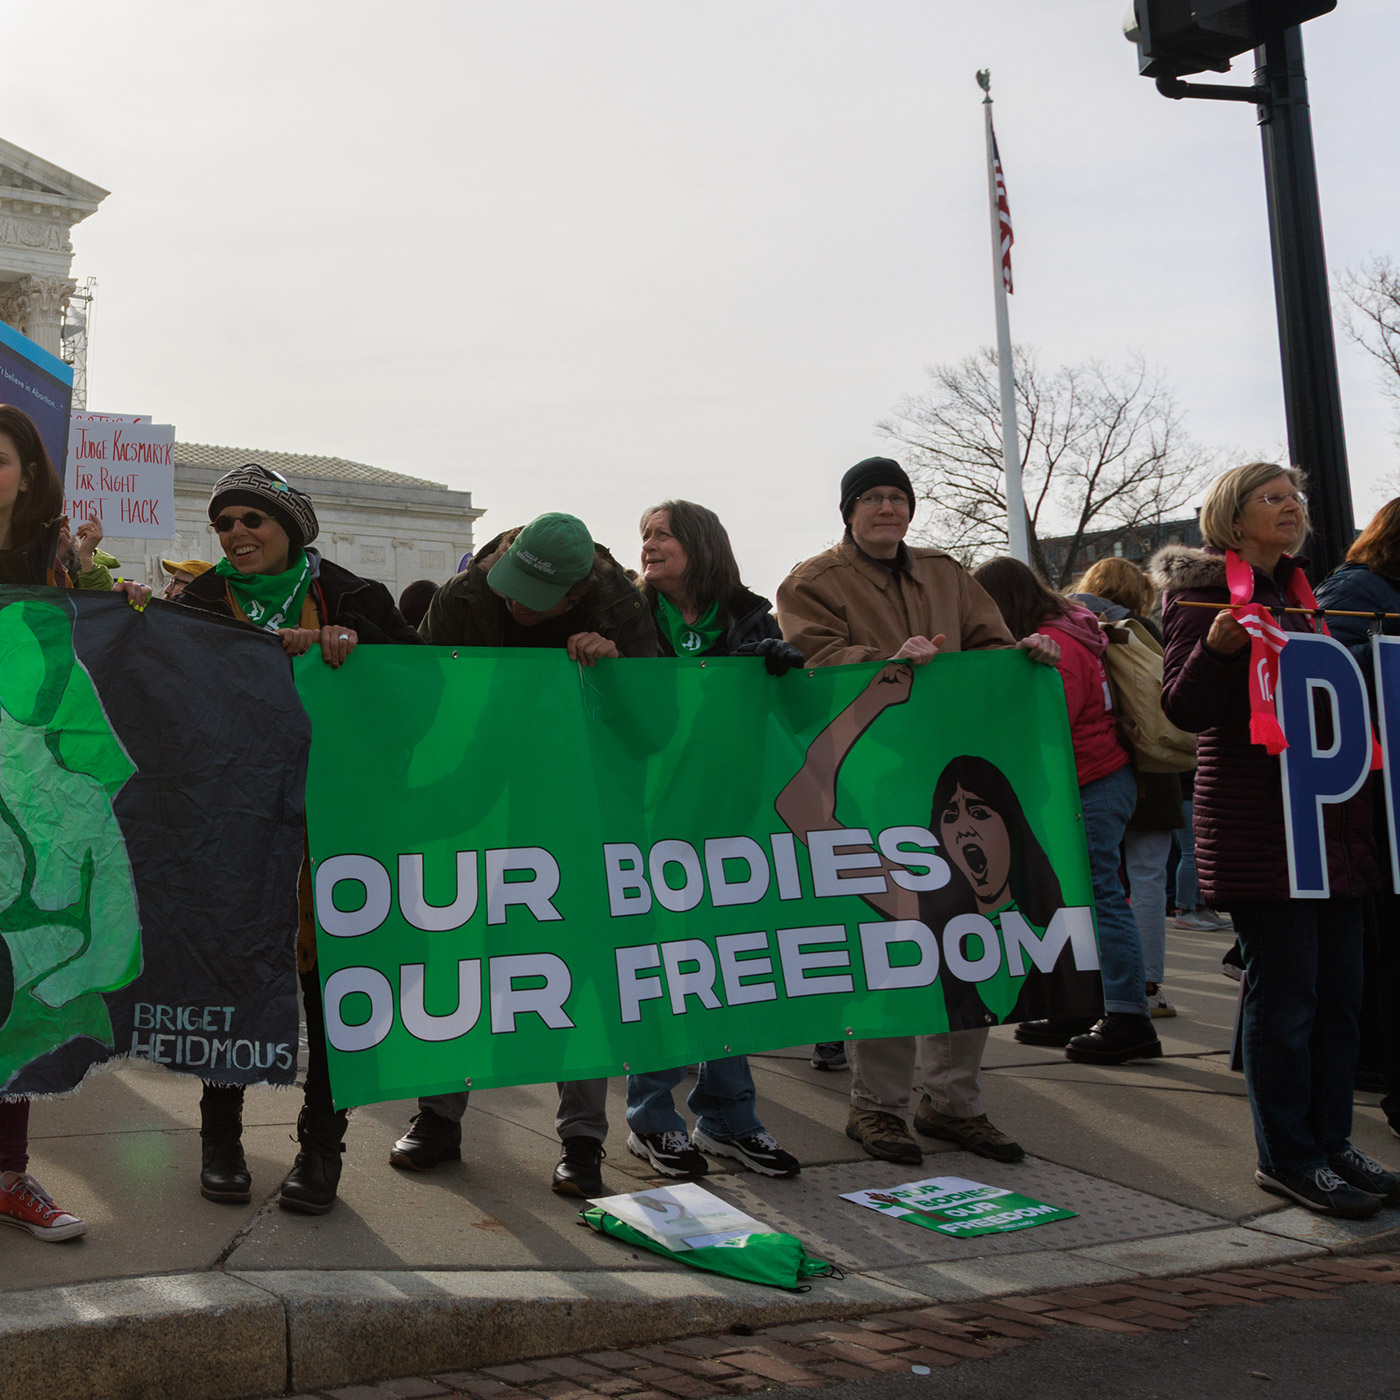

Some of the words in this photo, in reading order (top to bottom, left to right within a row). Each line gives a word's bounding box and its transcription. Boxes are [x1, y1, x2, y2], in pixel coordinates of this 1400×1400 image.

[4, 369, 25, 388] believe
[25, 382, 31, 393] in
[120, 498, 160, 526] HACK
[314, 845, 566, 938] OUR
[602, 825, 952, 917] BODIES
[323, 951, 577, 1053] OUR
[614, 905, 1100, 1024] FREEDOM
[133, 1002, 235, 1032] BRIGET
[131, 1031, 293, 1070] HEIDMOUS
[891, 1185, 944, 1199] OUR
[914, 1187, 1002, 1208] BODIES
[937, 1204, 1060, 1233] FREEDOM
[944, 1202, 1002, 1217] OUR
